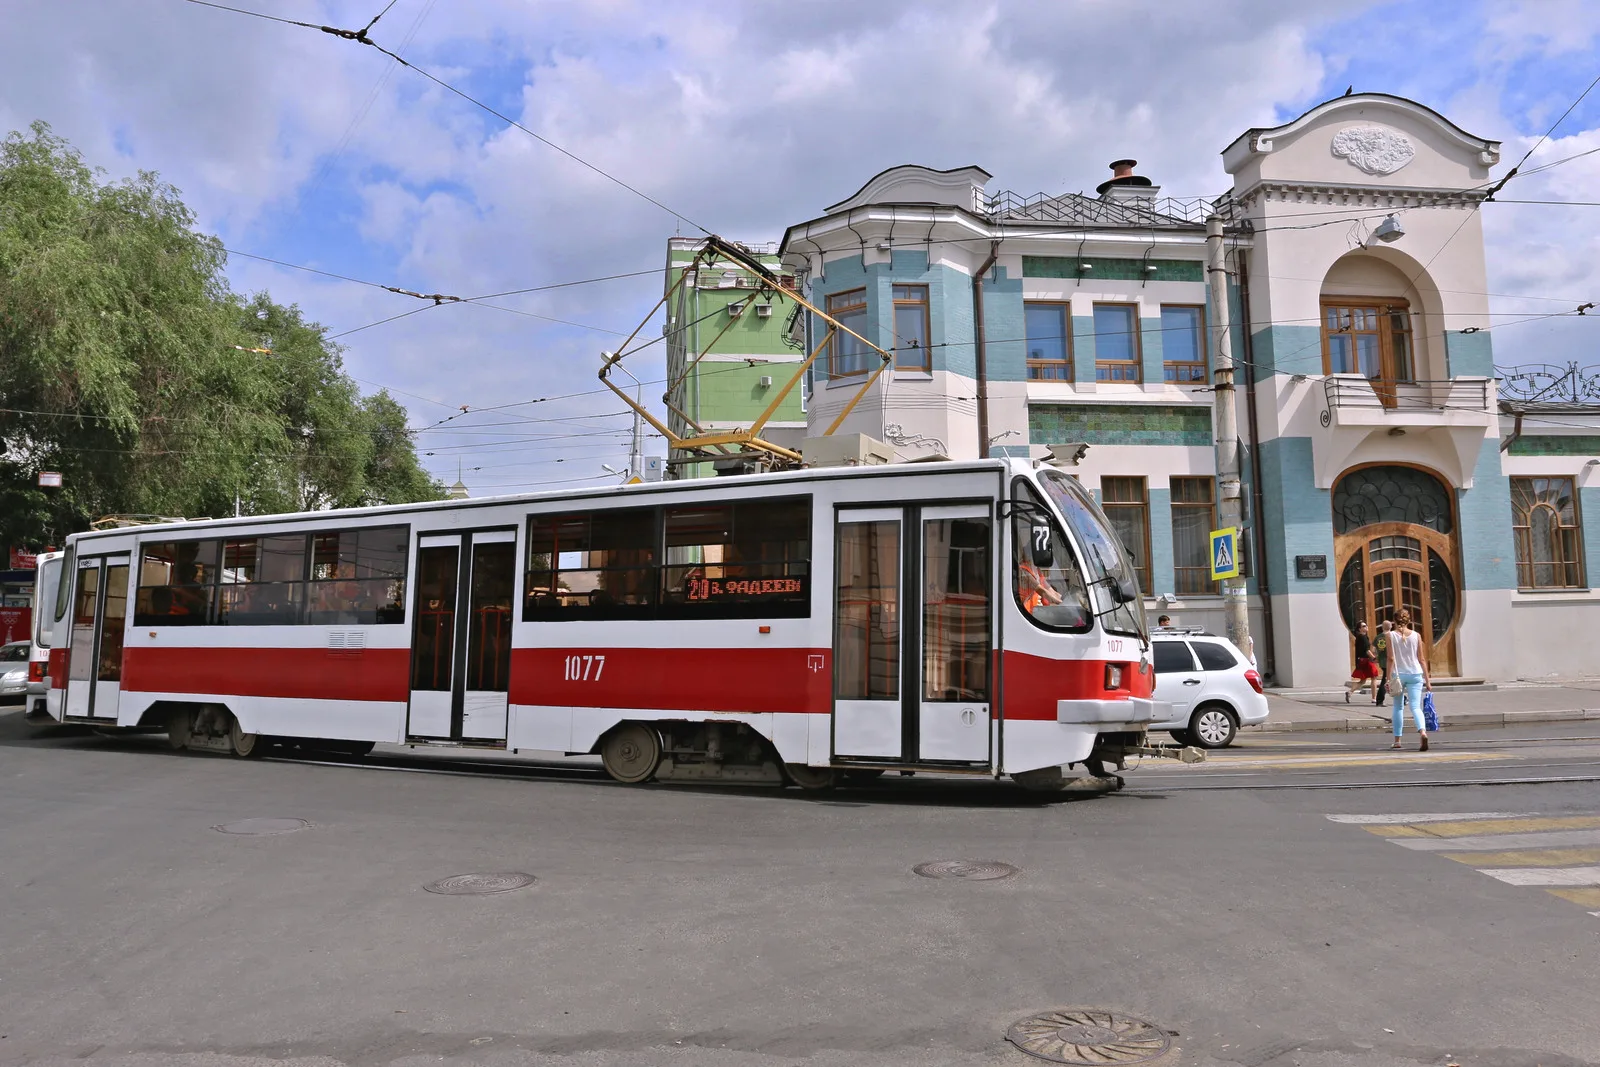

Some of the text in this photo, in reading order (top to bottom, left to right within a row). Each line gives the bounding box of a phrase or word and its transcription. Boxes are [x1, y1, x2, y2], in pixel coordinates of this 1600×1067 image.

[1033, 526, 1049, 551] 77
[688, 579, 709, 600] 20
[1108, 640, 1122, 652] 1077
[565, 655, 605, 681] 1077
